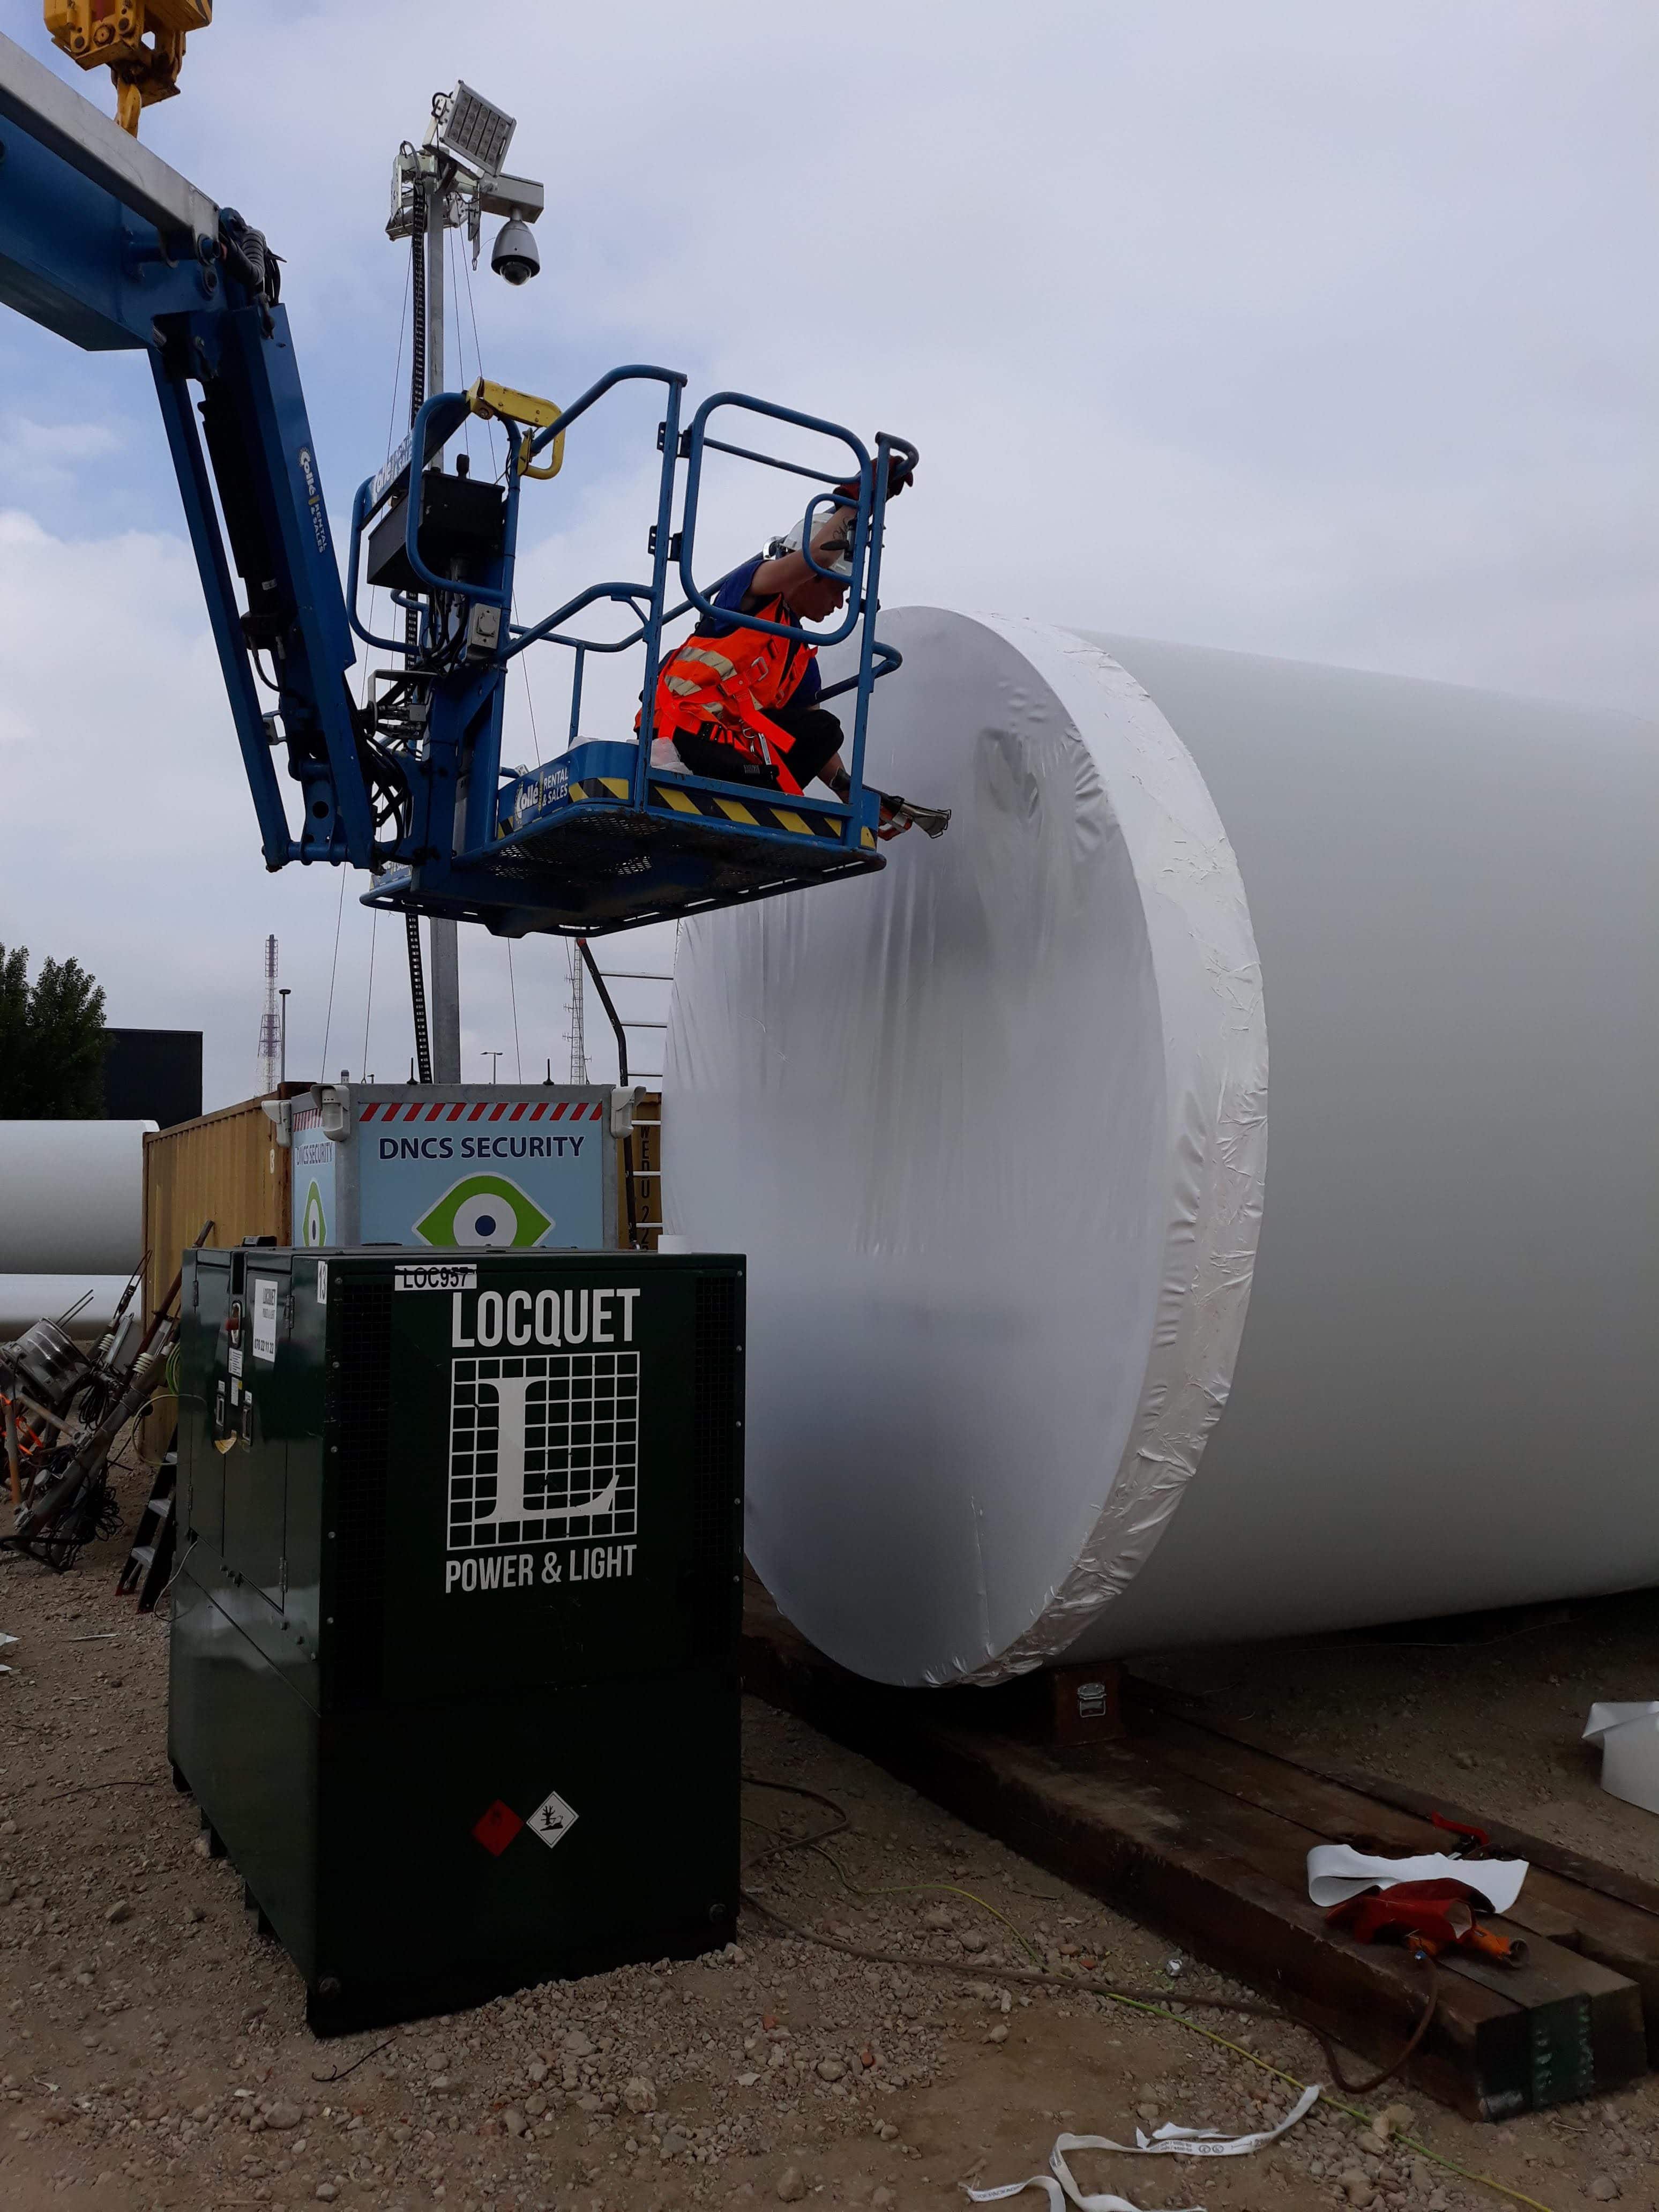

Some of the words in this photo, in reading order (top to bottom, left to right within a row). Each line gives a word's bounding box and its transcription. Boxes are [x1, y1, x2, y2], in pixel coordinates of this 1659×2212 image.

[313, 517, 324, 553] SALES
[315, 504, 326, 550] RENTAL
[543, 767, 569, 791] RENTAL
[542, 794, 547, 807] &
[548, 783, 568, 804] SALES
[310, 1142, 332, 1164] SECURITY
[379, 1136, 454, 1160] DNCS
[460, 1135, 585, 1159] SECURITY
[319, 1265, 326, 1300] 13
[403, 1266, 468, 1288] LOC957
[452, 1288, 640, 1347] LOCQUET
[446, 1553, 533, 1593] POWER
[541, 1551, 562, 1583] &
[570, 1544, 637, 1580] LIGHT
